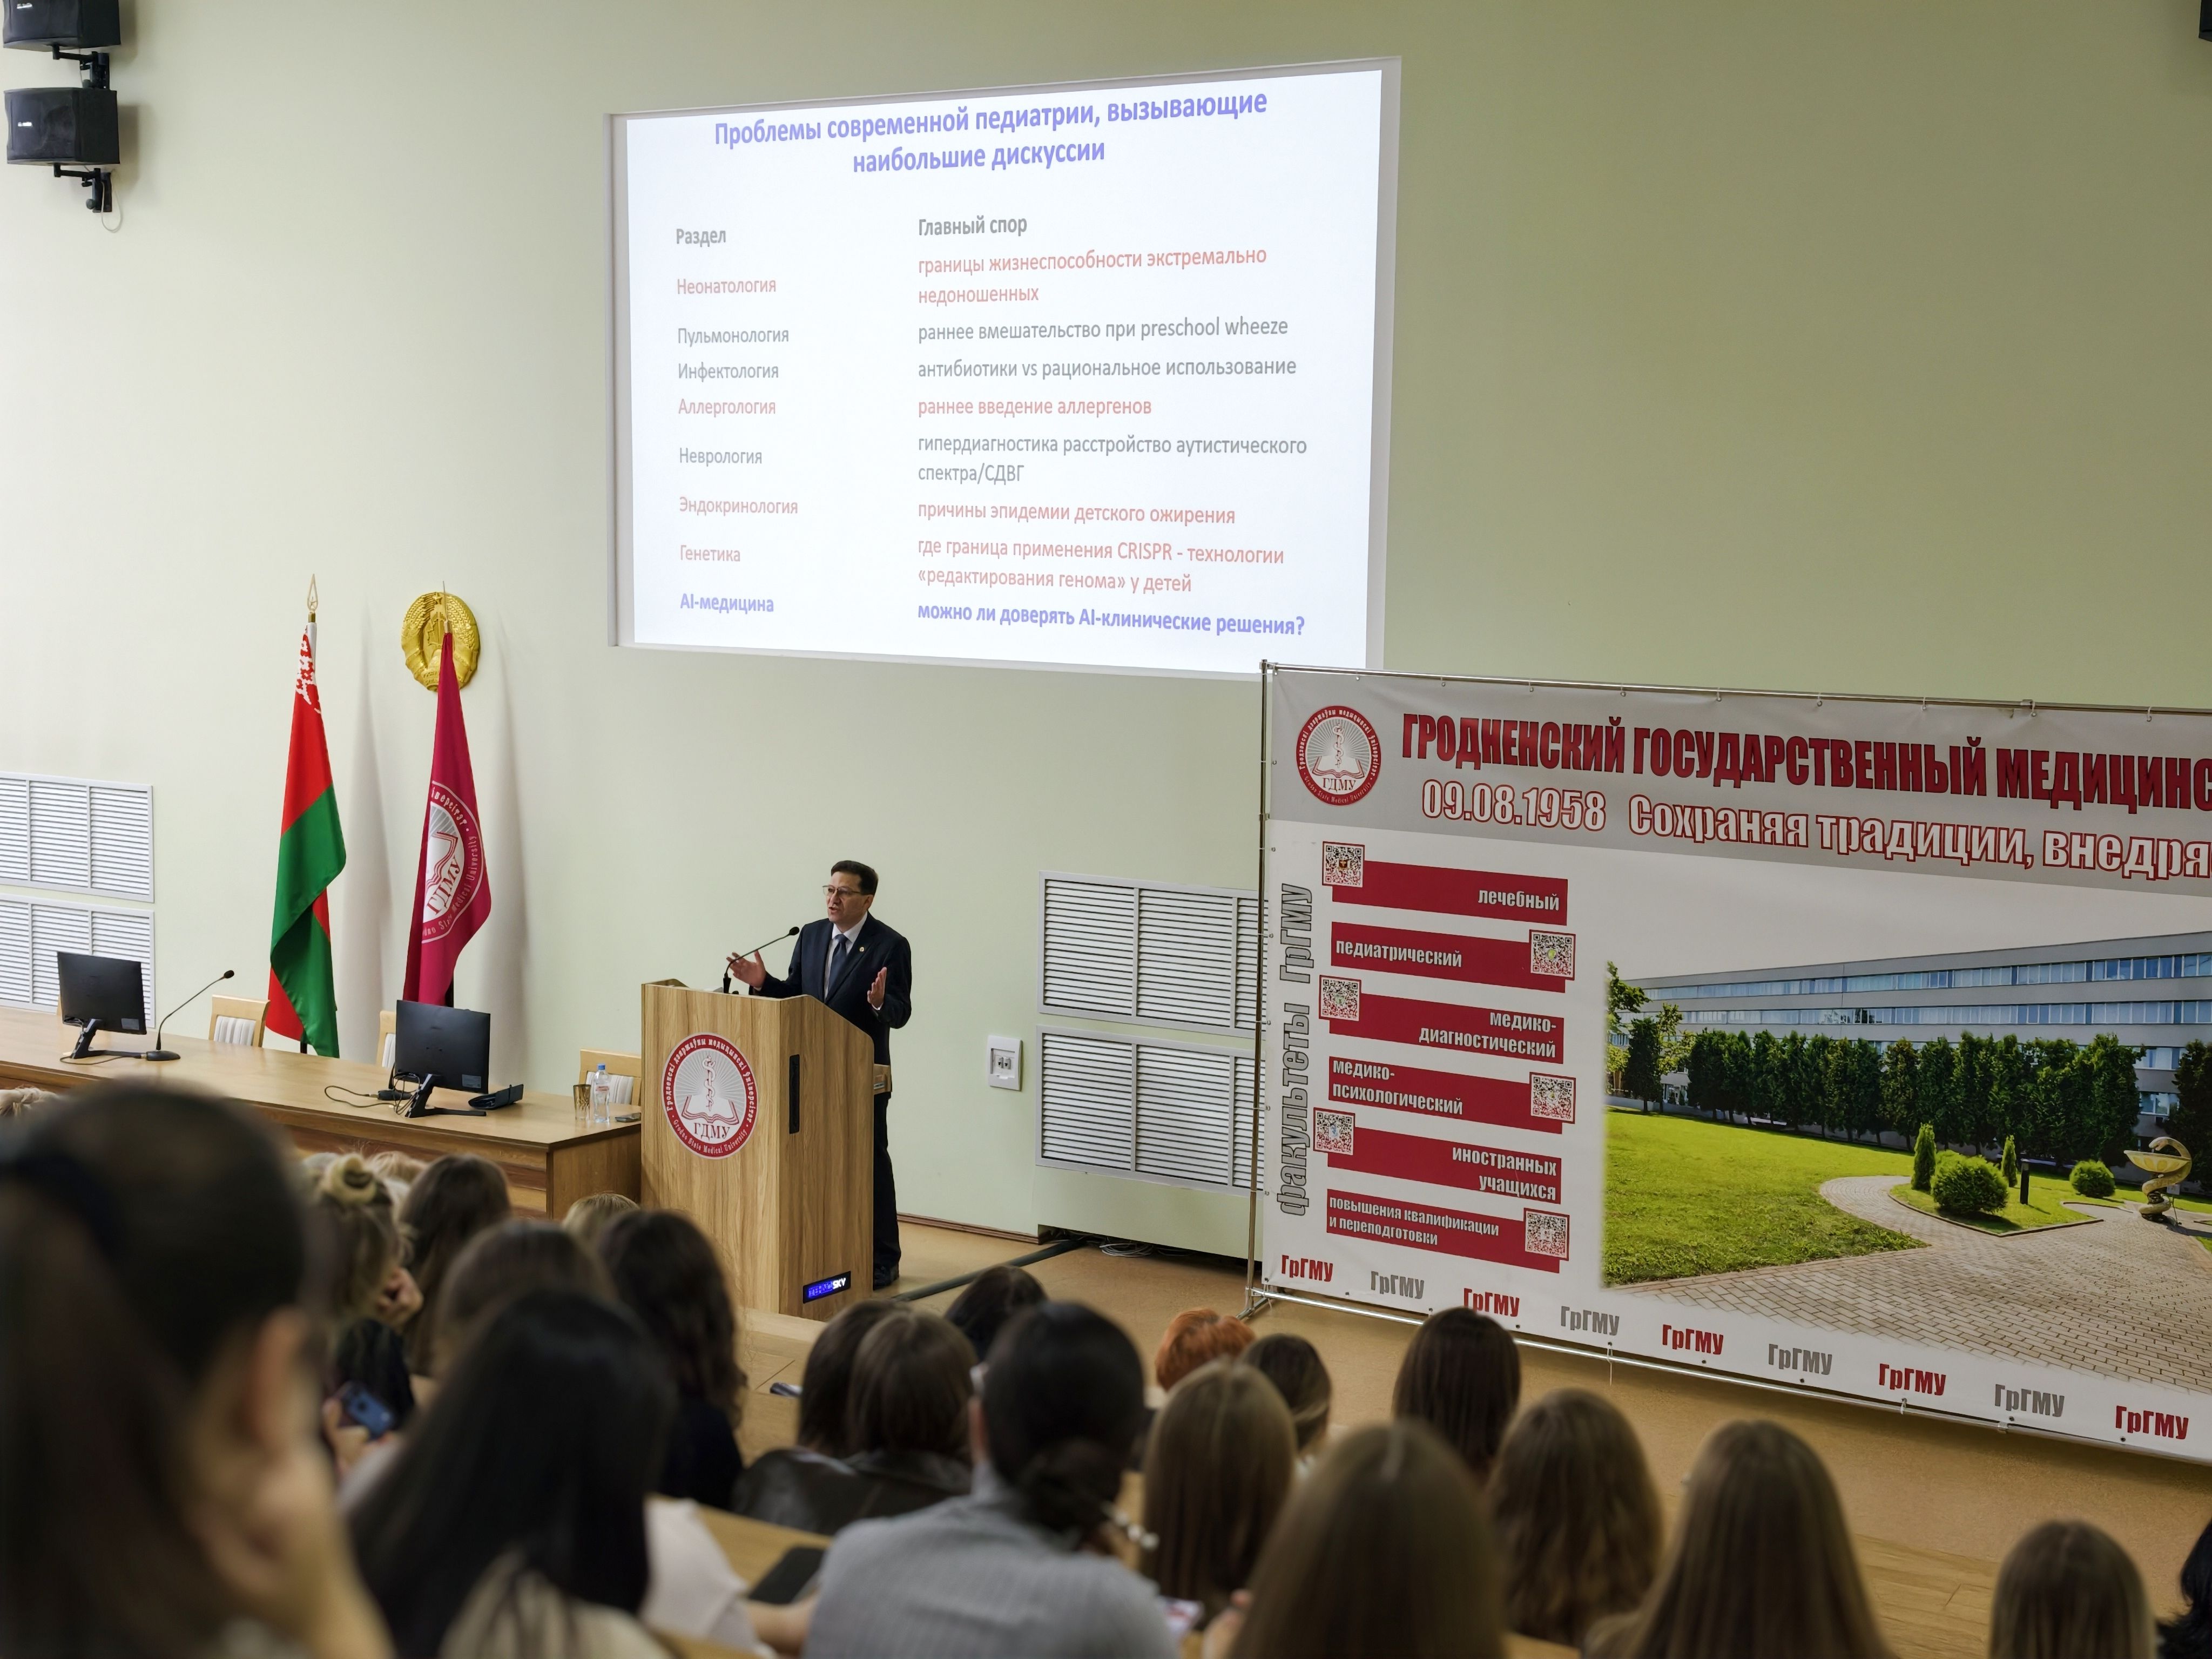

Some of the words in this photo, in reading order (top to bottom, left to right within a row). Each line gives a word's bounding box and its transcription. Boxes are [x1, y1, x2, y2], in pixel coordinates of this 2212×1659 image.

[716, 119, 821, 150] Проблемы
[828, 106, 968, 142] современной
[976, 105, 1100, 133] педиатрии,
[1108, 93, 1267, 122] вызывающие
[854, 146, 986, 172] наибольшие
[992, 143, 1104, 171] дискуссии
[677, 228, 726, 247] Раздел
[919, 215, 984, 235] Главный
[990, 218, 1027, 237] спор
[919, 259, 983, 277] границы
[989, 249, 1142, 271] жизнеспособности
[1148, 249, 1266, 269] экстремально
[678, 279, 776, 294] Неонатология
[919, 288, 1038, 307] недоношенных
[678, 328, 788, 347] Пульмонология
[919, 327, 973, 344] раннее
[979, 325, 1101, 339] вмешательство
[1106, 324, 1135, 341] при
[1142, 316, 1219, 341] preschool
[1225, 316, 1287, 335] wheeze
[679, 362, 778, 382] Инфектология
[919, 359, 1017, 376] антибиотики
[1022, 364, 1037, 376] vs
[1043, 362, 1161, 380] рациональное
[1166, 361, 1296, 375] использование
[678, 399, 775, 417] Аллергология
[919, 402, 973, 417] раннее
[979, 402, 1052, 418] введение
[1058, 401, 1151, 418] аллергенов
[919, 439, 1057, 455] гипердиагностика
[1064, 434, 1171, 456] расстройство
[1177, 440, 1306, 457] аутистического
[680, 448, 761, 467] Неврология
[919, 463, 1024, 485] спектра/СДВГ
[680, 497, 798, 516] Эндокринология
[919, 504, 986, 521] причины
[991, 506, 1069, 523] эпидемии
[1074, 508, 1144, 524] детского
[1150, 509, 1235, 527] ожирения
[681, 545, 740, 562] Генетика
[919, 541, 941, 557] где
[947, 542, 1007, 559] граница
[1014, 544, 1112, 559] применения
[1118, 542, 1172, 561] CRISPR
[1187, 548, 1283, 564] технологии
[919, 570, 1053, 588] «редактирования
[1060, 575, 1125, 589] генома»
[1131, 577, 1139, 594] у
[1143, 574, 1191, 594] детей
[918, 605, 972, 620] можно
[976, 608, 995, 621] ли
[1000, 609, 1075, 628] доверять
[1217, 616, 1304, 636] решения?
[1403, 713, 1625, 773] ГРОДНЕНСКИЙ
[1633, 727, 1987, 796] ГОСУДАРСТВЕННЫЙ
[1995, 748, 2212, 814] МЕДИЦИНС
[1322, 777, 1357, 793] ГДМУ
[1422, 779, 1606, 831] 09.08.1958
[1629, 794, 1809, 848] Сохраняя
[1816, 815, 2034, 869] традиции,
[2043, 831, 2212, 881] внедря
[426, 855, 462, 916] ГДМУ
[1478, 890, 1559, 911] лечебный
[1280, 884, 1314, 983] ГрГМУ
[1337, 941, 1462, 967] педиатрический
[1491, 1012, 1556, 1032] медико-
[1419, 1028, 1555, 1057] диагностический
[1333, 1061, 1394, 1080] медико-
[1277, 1003, 1310, 1216] факультеты
[1332, 1084, 1463, 1116] психологический
[693, 1122, 731, 1141] ГДМУ
[1453, 1147, 1556, 1176] иностранных
[1479, 1176, 1556, 1201] учащихся
[1330, 1197, 1401, 1219] повышения
[1404, 1208, 1499, 1237] квалификации
[1330, 1217, 1337, 1228] и
[1339, 1217, 1438, 1245] переподготовки
[1282, 1255, 1333, 1282] ГрГМУ
[1371, 1271, 1424, 1299] ГрГМУ
[1464, 1288, 1519, 1318] ГрГМУ
[1561, 1306, 1619, 1336] ГрГМУ
[1662, 1324, 1723, 1355] ГрГМУ
[1769, 1344, 1832, 1375] ГрГМУ
[1879, 1364, 1946, 1395] ГрГМУ
[1995, 1384, 2065, 1417] ГрГМУ
[2116, 1406, 2189, 1442] ГрГМУ
